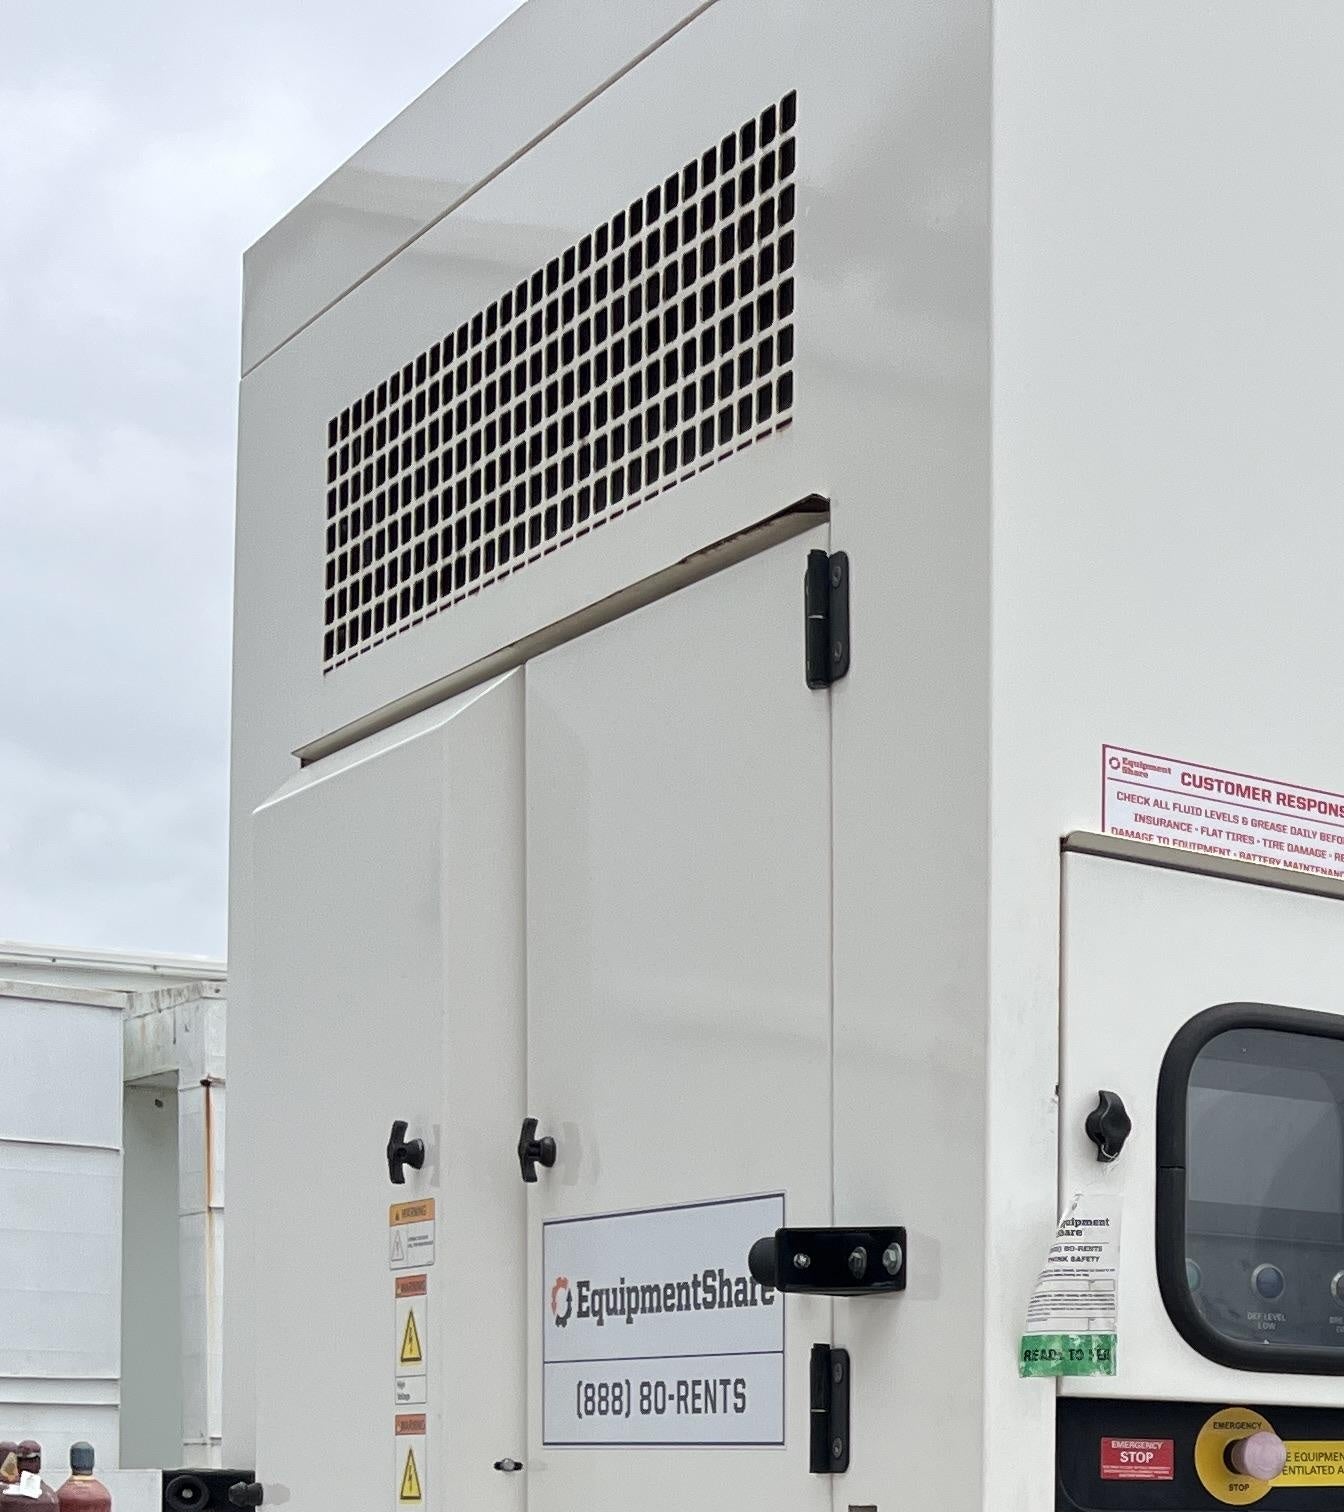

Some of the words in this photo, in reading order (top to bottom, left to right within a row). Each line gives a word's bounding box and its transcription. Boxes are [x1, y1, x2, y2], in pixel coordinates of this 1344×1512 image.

[1180, 771, 1272, 804] CUSTOMER
[1116, 791, 1151, 807] CHECK
[1152, 798, 1171, 811] ALL
[1172, 803, 1202, 817] FLUID
[1204, 809, 1239, 825] LEVELS
[1251, 818, 1288, 834] GREASE
[1290, 826, 1318, 841] DAILY
[1133, 813, 1193, 833] INSURANCE
[1200, 826, 1224, 840] FLAT
[1226, 831, 1255, 845] TIRES
[1262, 838, 1285, 851] TIRE
[1286, 843, 1327, 859] DAMAGE
[576, 1378, 631, 1419] (888)
[639, 1378, 747, 1416] 80-RENTS
[1213, 1421, 1263, 1430] EMERGENCY
[1111, 1440, 1163, 1450] EMERGENCY
[1120, 1451, 1154, 1464] STOP
[1282, 1464, 1335, 1475] ENTILATED
[1228, 1483, 1250, 1492] STOP
